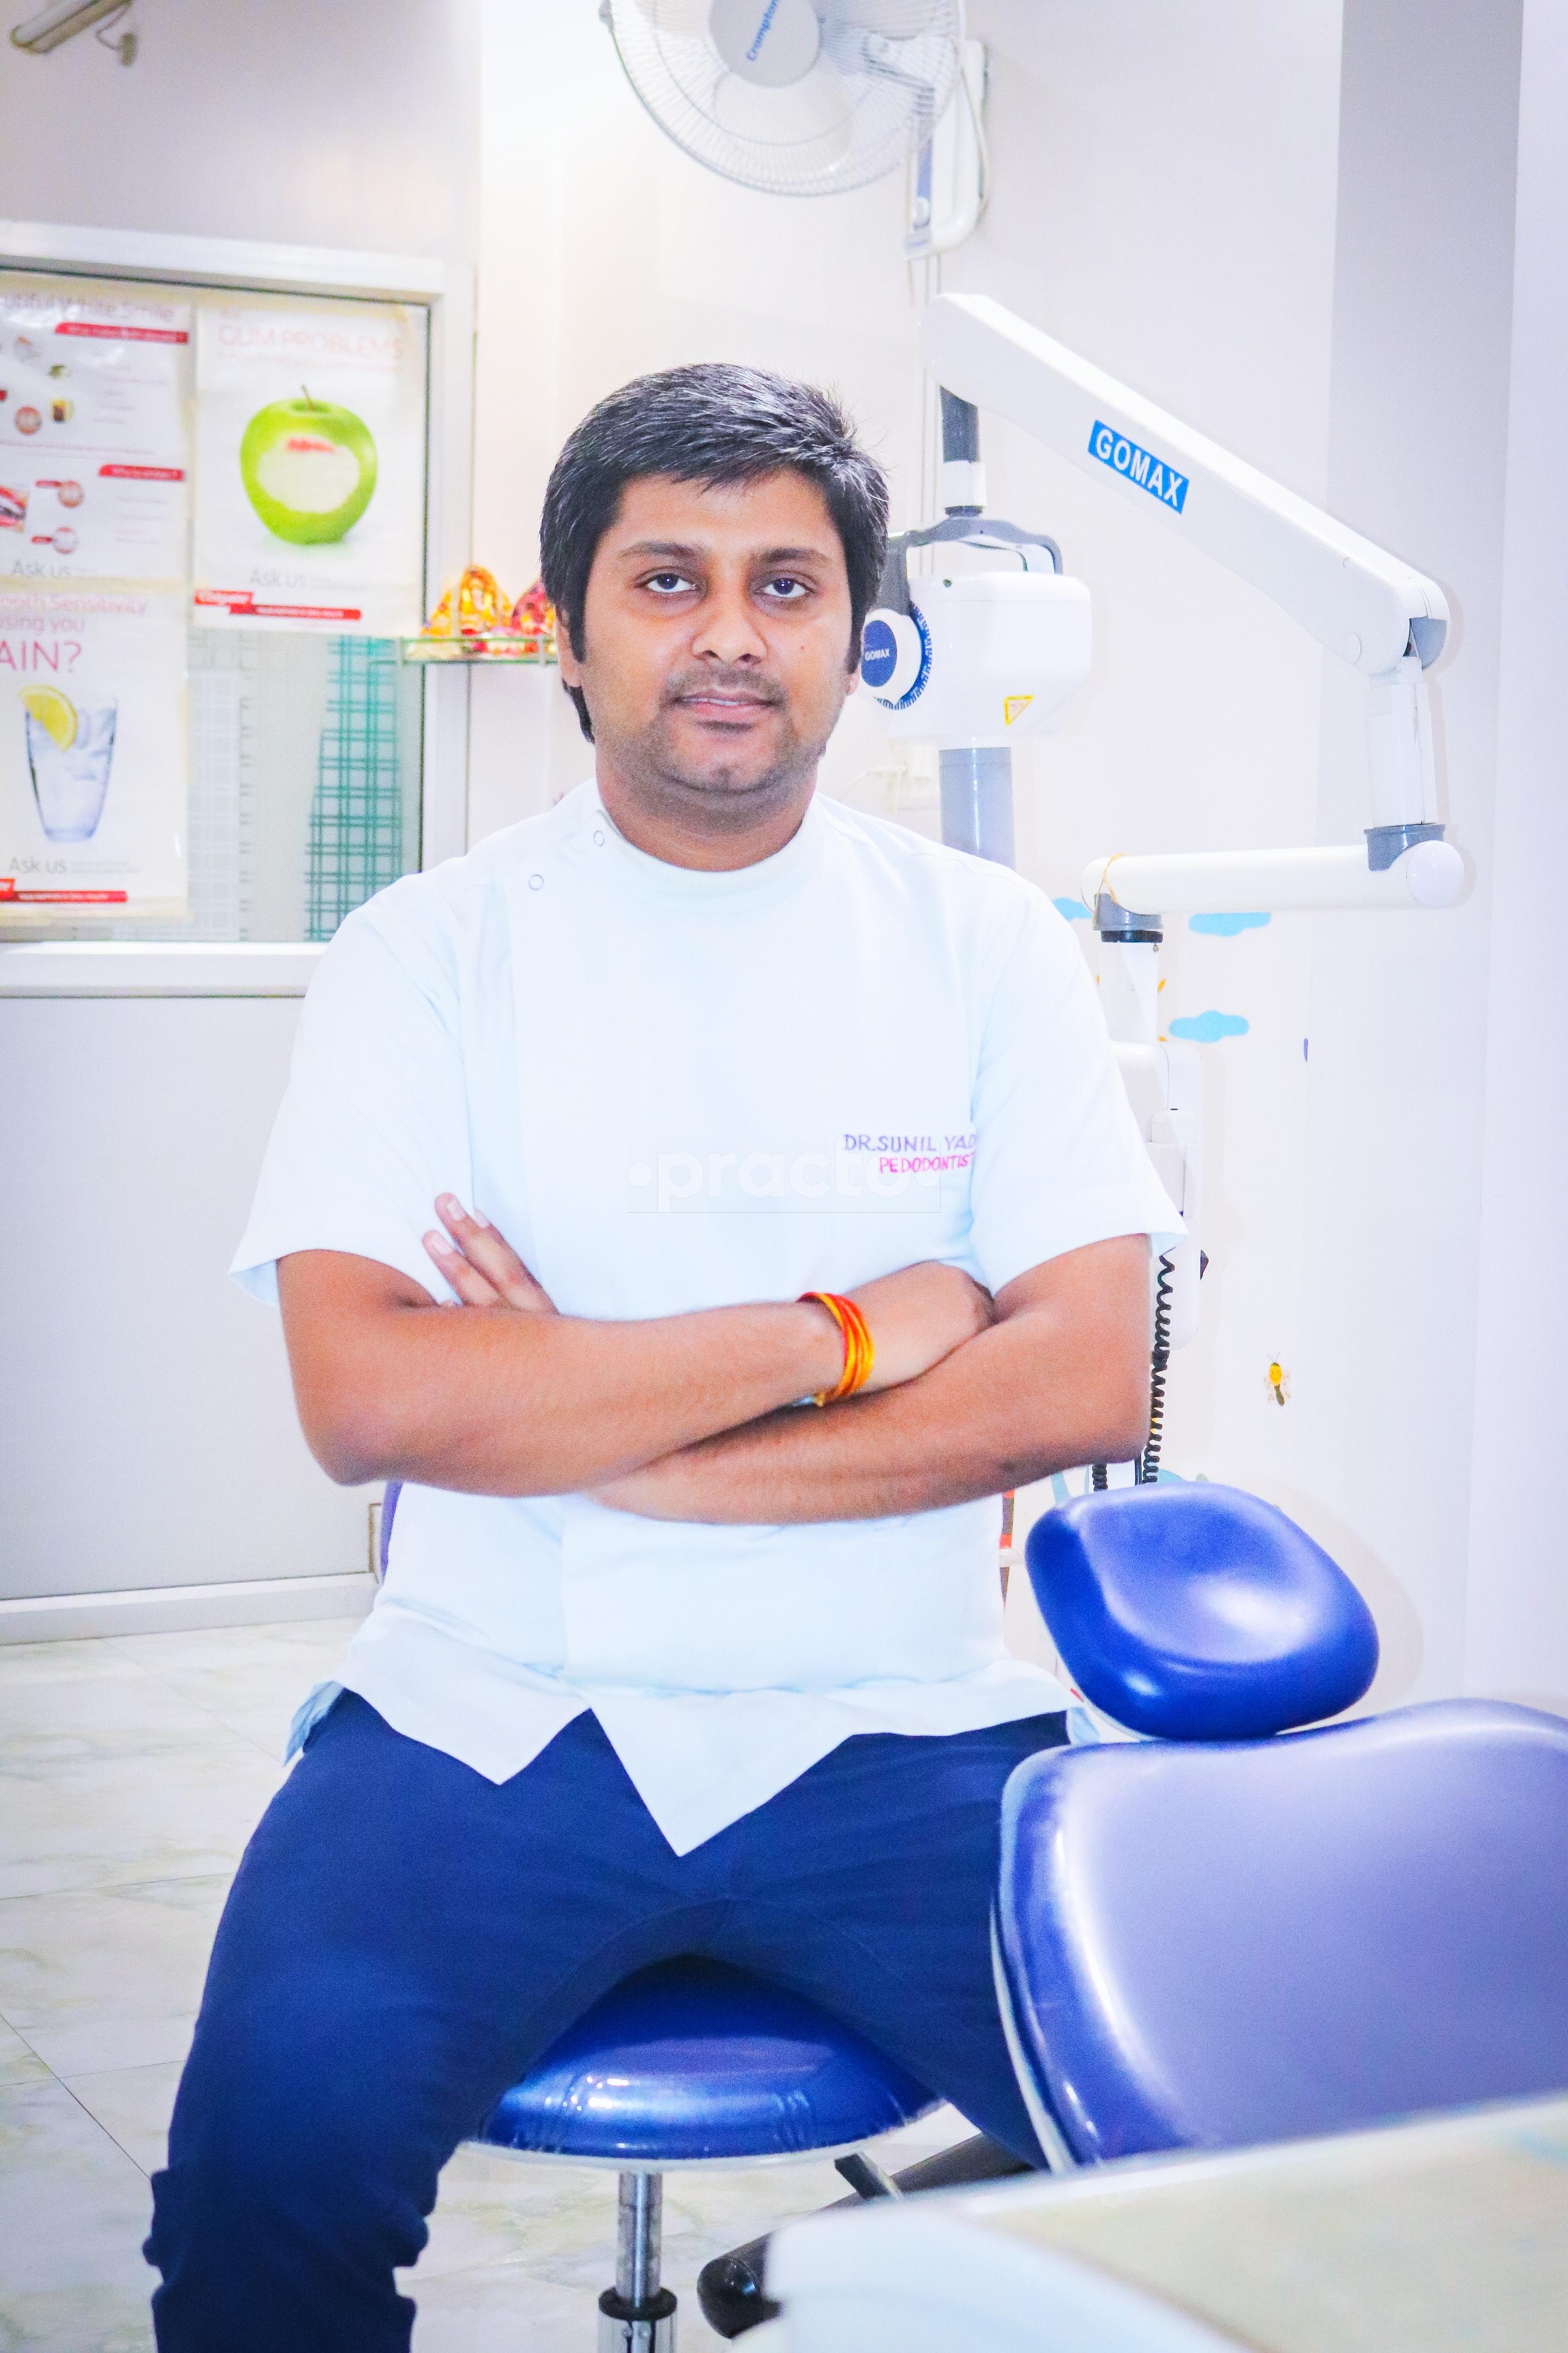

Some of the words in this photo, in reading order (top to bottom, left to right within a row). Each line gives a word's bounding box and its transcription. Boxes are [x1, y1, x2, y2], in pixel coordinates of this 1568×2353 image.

[1096, 428, 1183, 508] GOMAX
[12, 560, 45, 578] Ask
[50, 565, 71, 580] us
[50, 617, 86, 634] you
[0, 640, 82, 673] AIN?
[864, 648, 890, 661] GOMAX
[10, 857, 41, 874] Ask
[45, 861, 67, 874] us
